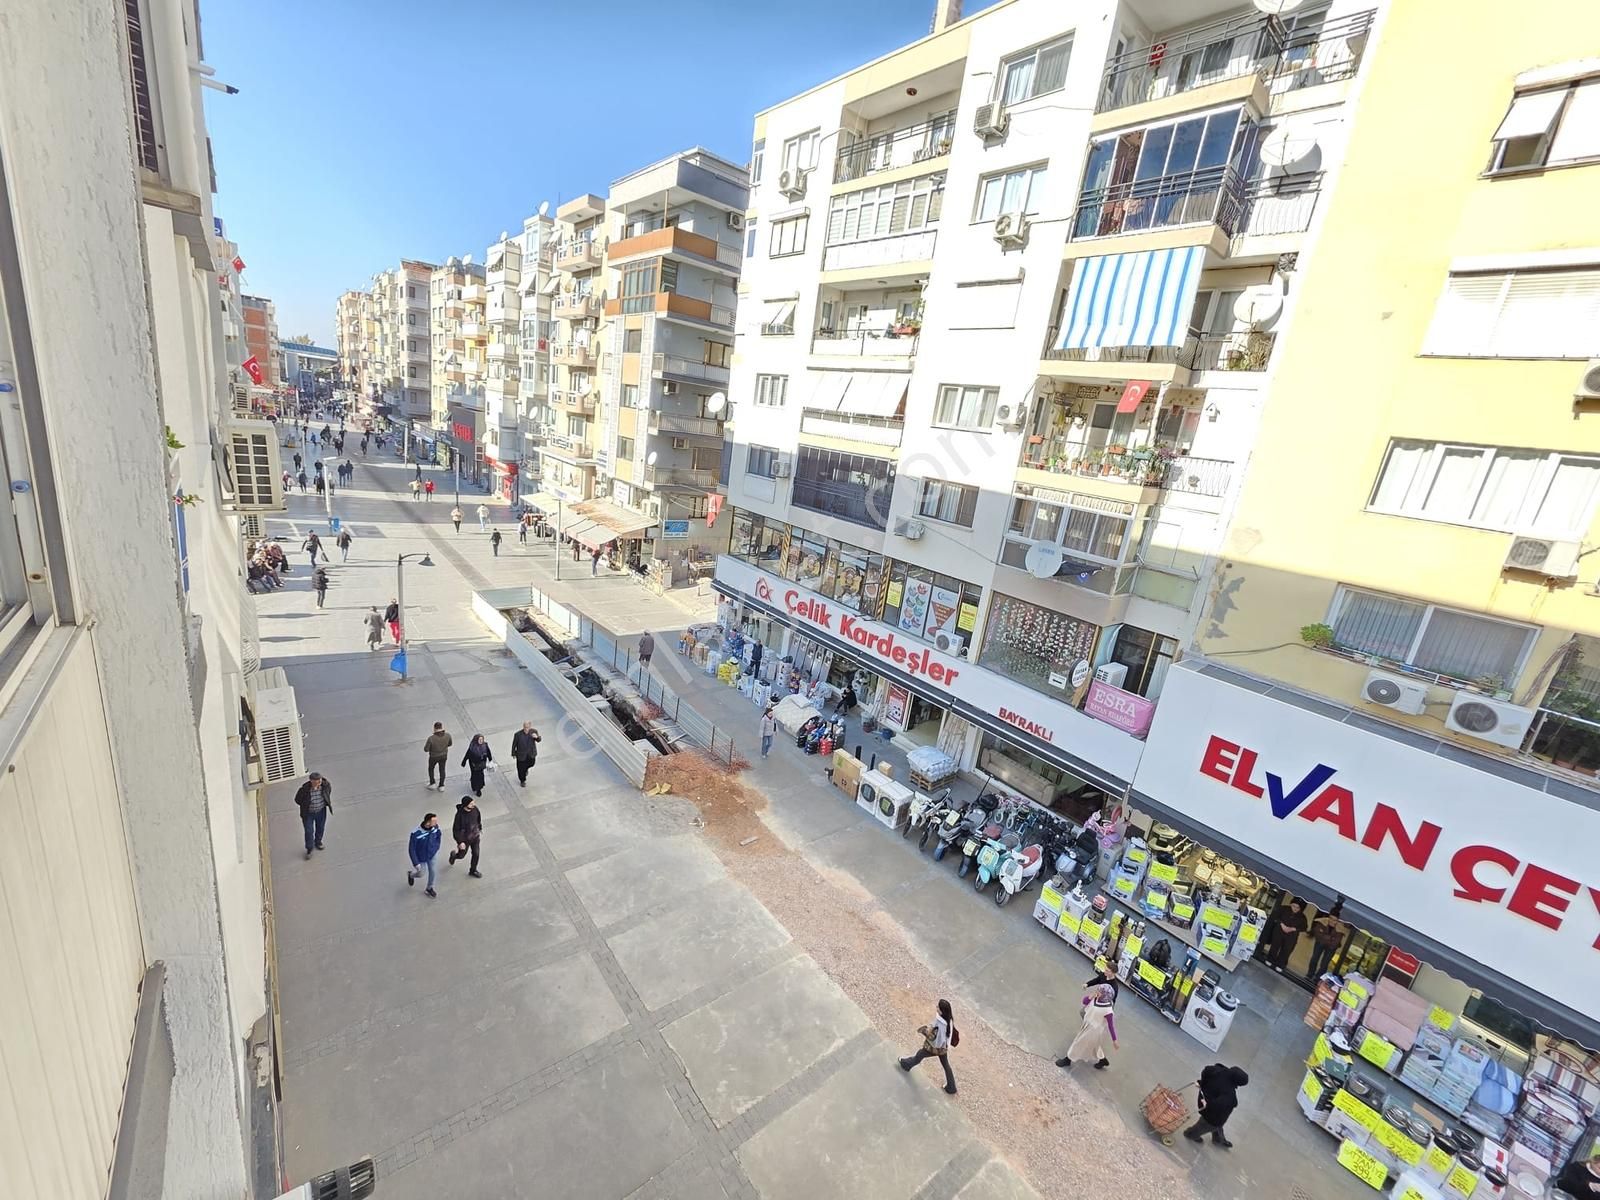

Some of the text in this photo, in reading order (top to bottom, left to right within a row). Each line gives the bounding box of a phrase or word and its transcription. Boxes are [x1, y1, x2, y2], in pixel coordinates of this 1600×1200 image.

[784, 589, 832, 629] Çelik
[840, 615, 960, 687] Kardeşler
[998, 706, 1055, 742] BAYRAKLI
[1093, 687, 1137, 718] ESRA
[1200, 734, 1443, 873] ELVAN
